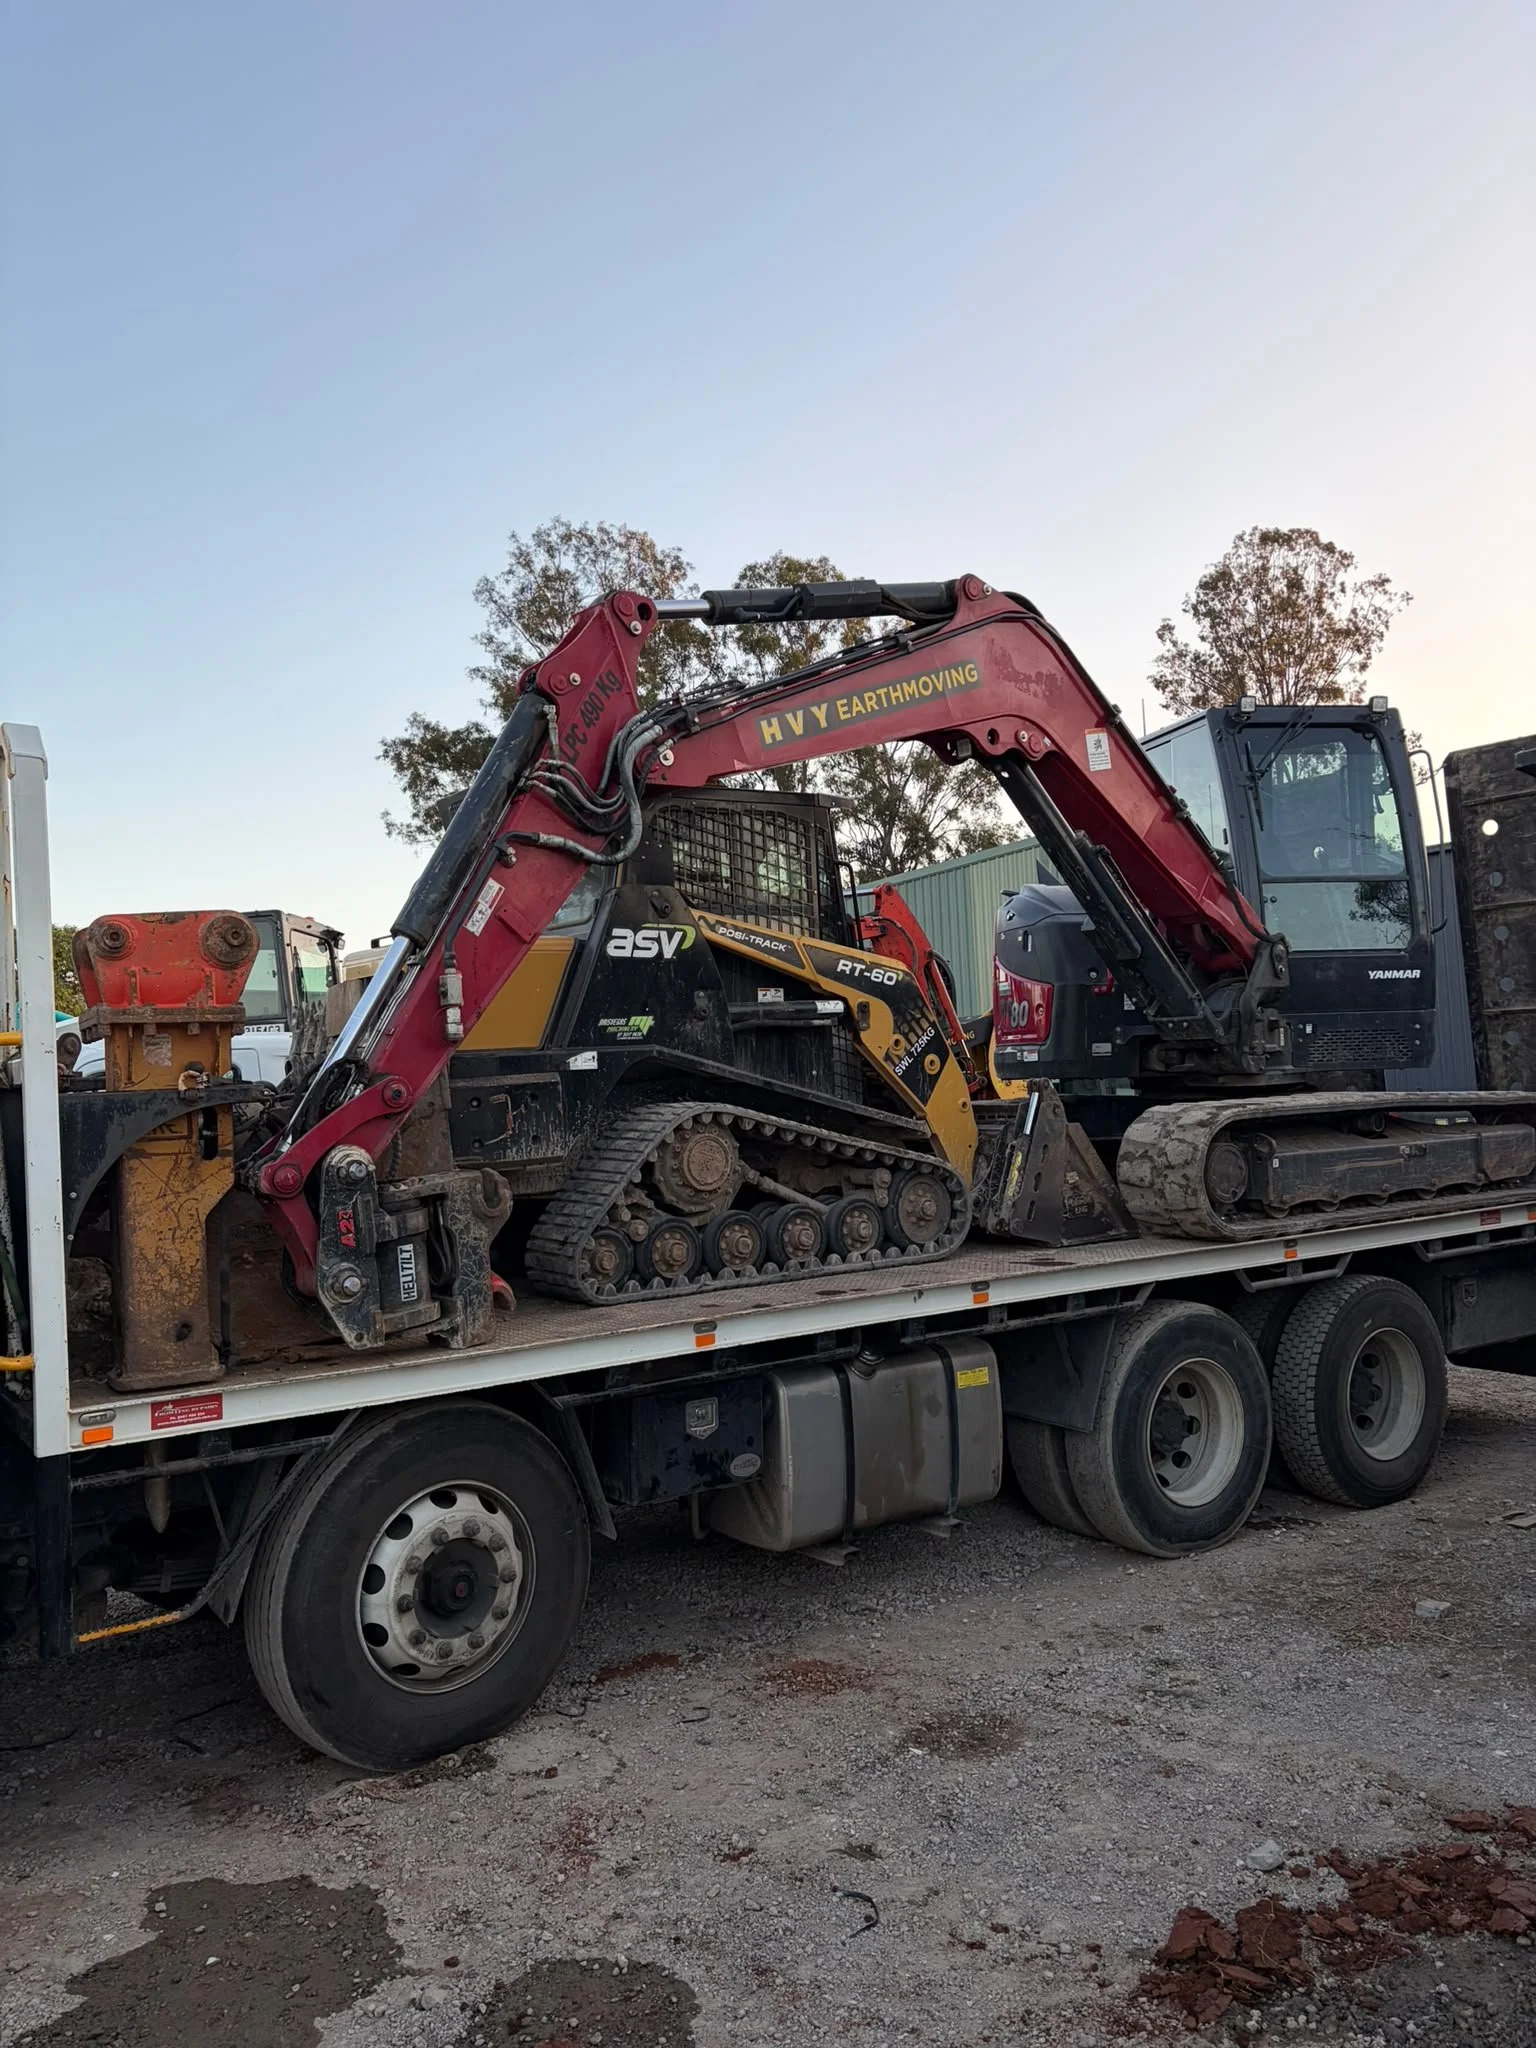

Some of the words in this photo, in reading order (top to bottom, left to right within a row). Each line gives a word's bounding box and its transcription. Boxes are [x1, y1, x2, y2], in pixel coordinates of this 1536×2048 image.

[579, 691, 606, 729] 490
[836, 663, 979, 721] EARTHMOVING
[836, 959, 898, 987] RT-60
[1367, 969, 1421, 980] YANMAR
[894, 1055, 914, 1076] SWL
[910, 1026, 936, 1056] 725KG
[399, 1247, 416, 1300] HELITILT
